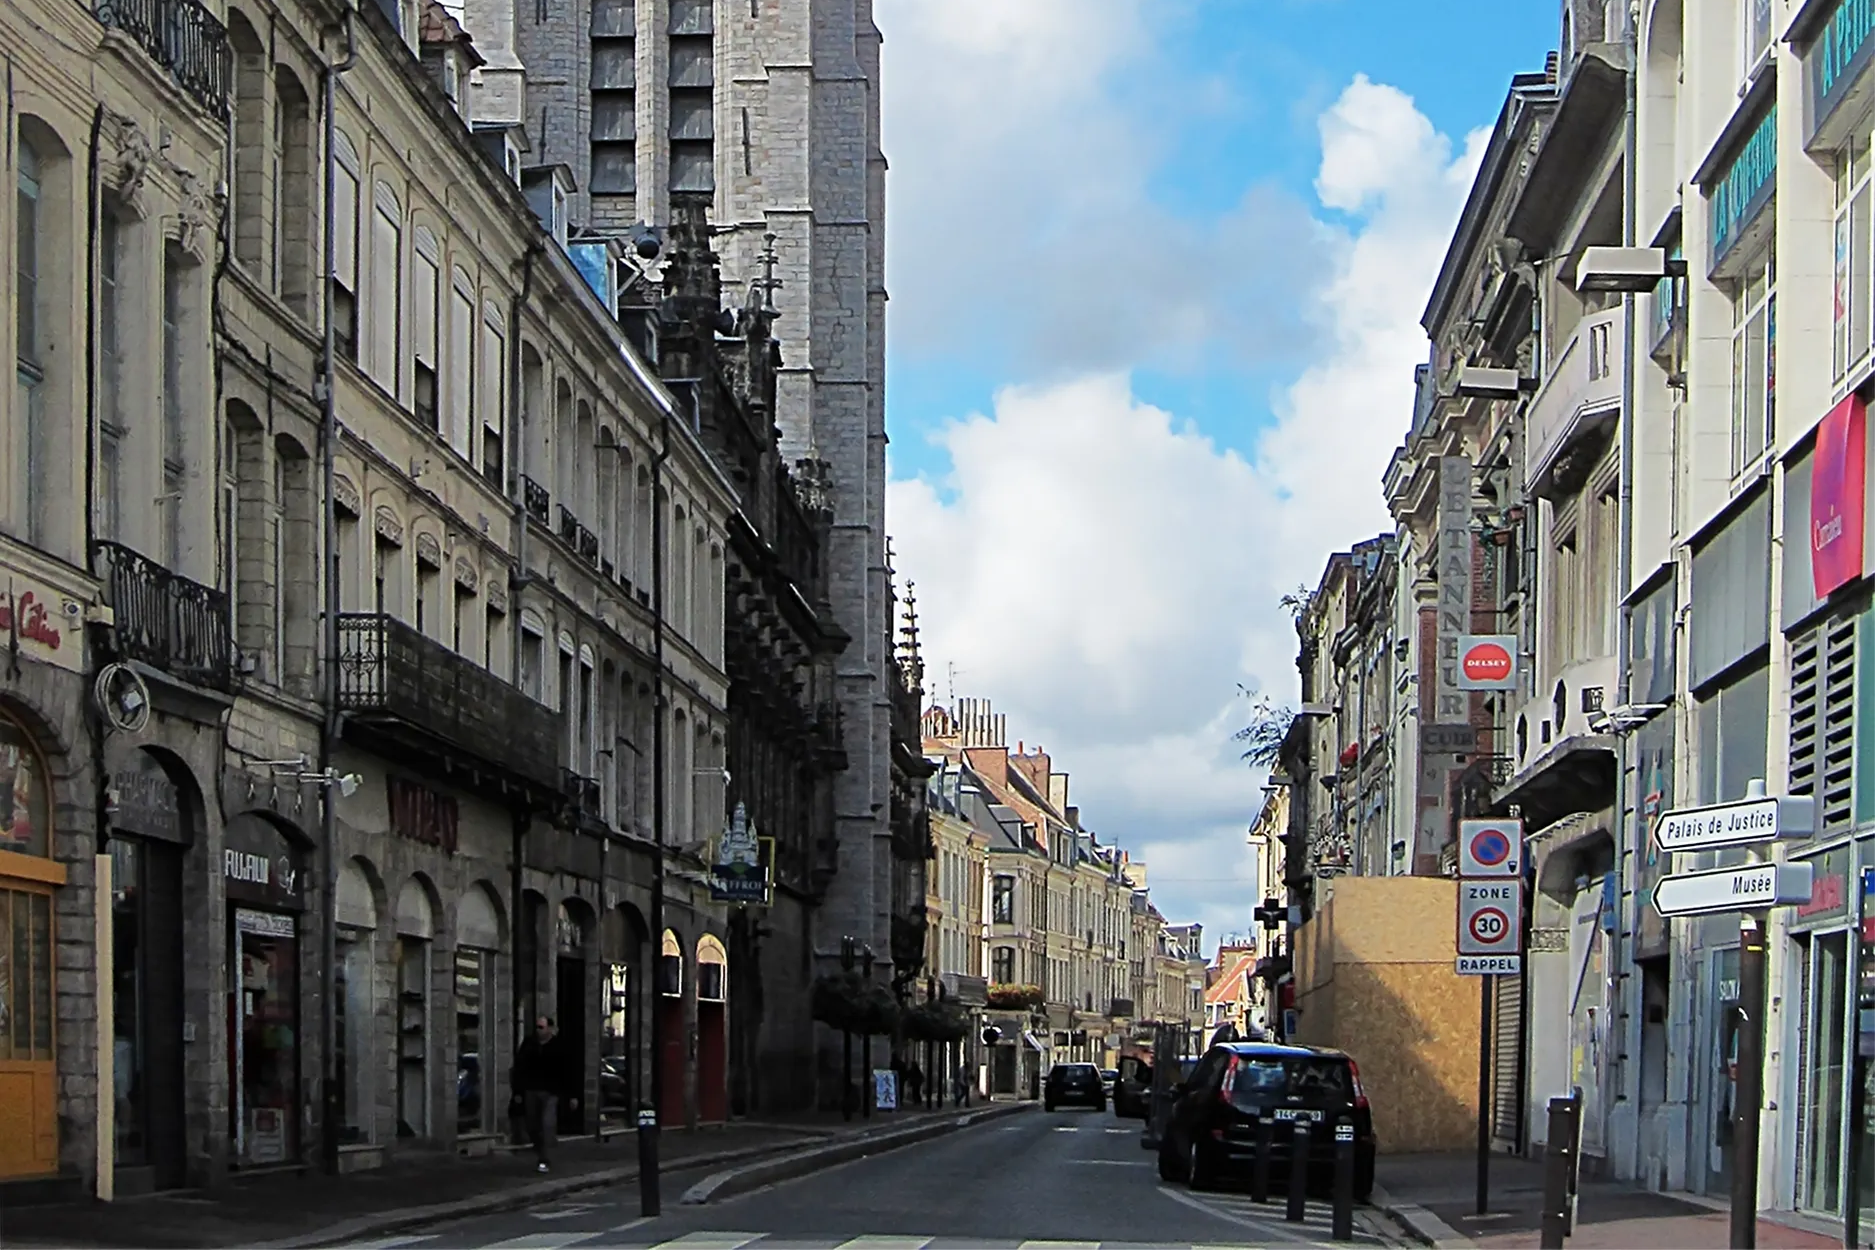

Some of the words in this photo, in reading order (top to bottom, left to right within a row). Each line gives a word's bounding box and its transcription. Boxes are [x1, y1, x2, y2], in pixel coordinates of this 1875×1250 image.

[1467, 659, 1507, 667] DELSEY
[1667, 819, 1703, 839] Palais
[1709, 816, 1722, 834] de
[1728, 810, 1774, 831] Justice
[1732, 874, 1771, 895] Musée
[1469, 888, 1510, 899] ZONE
[1477, 918, 1502, 933] 30
[1460, 959, 1515, 970] RAPPEL
